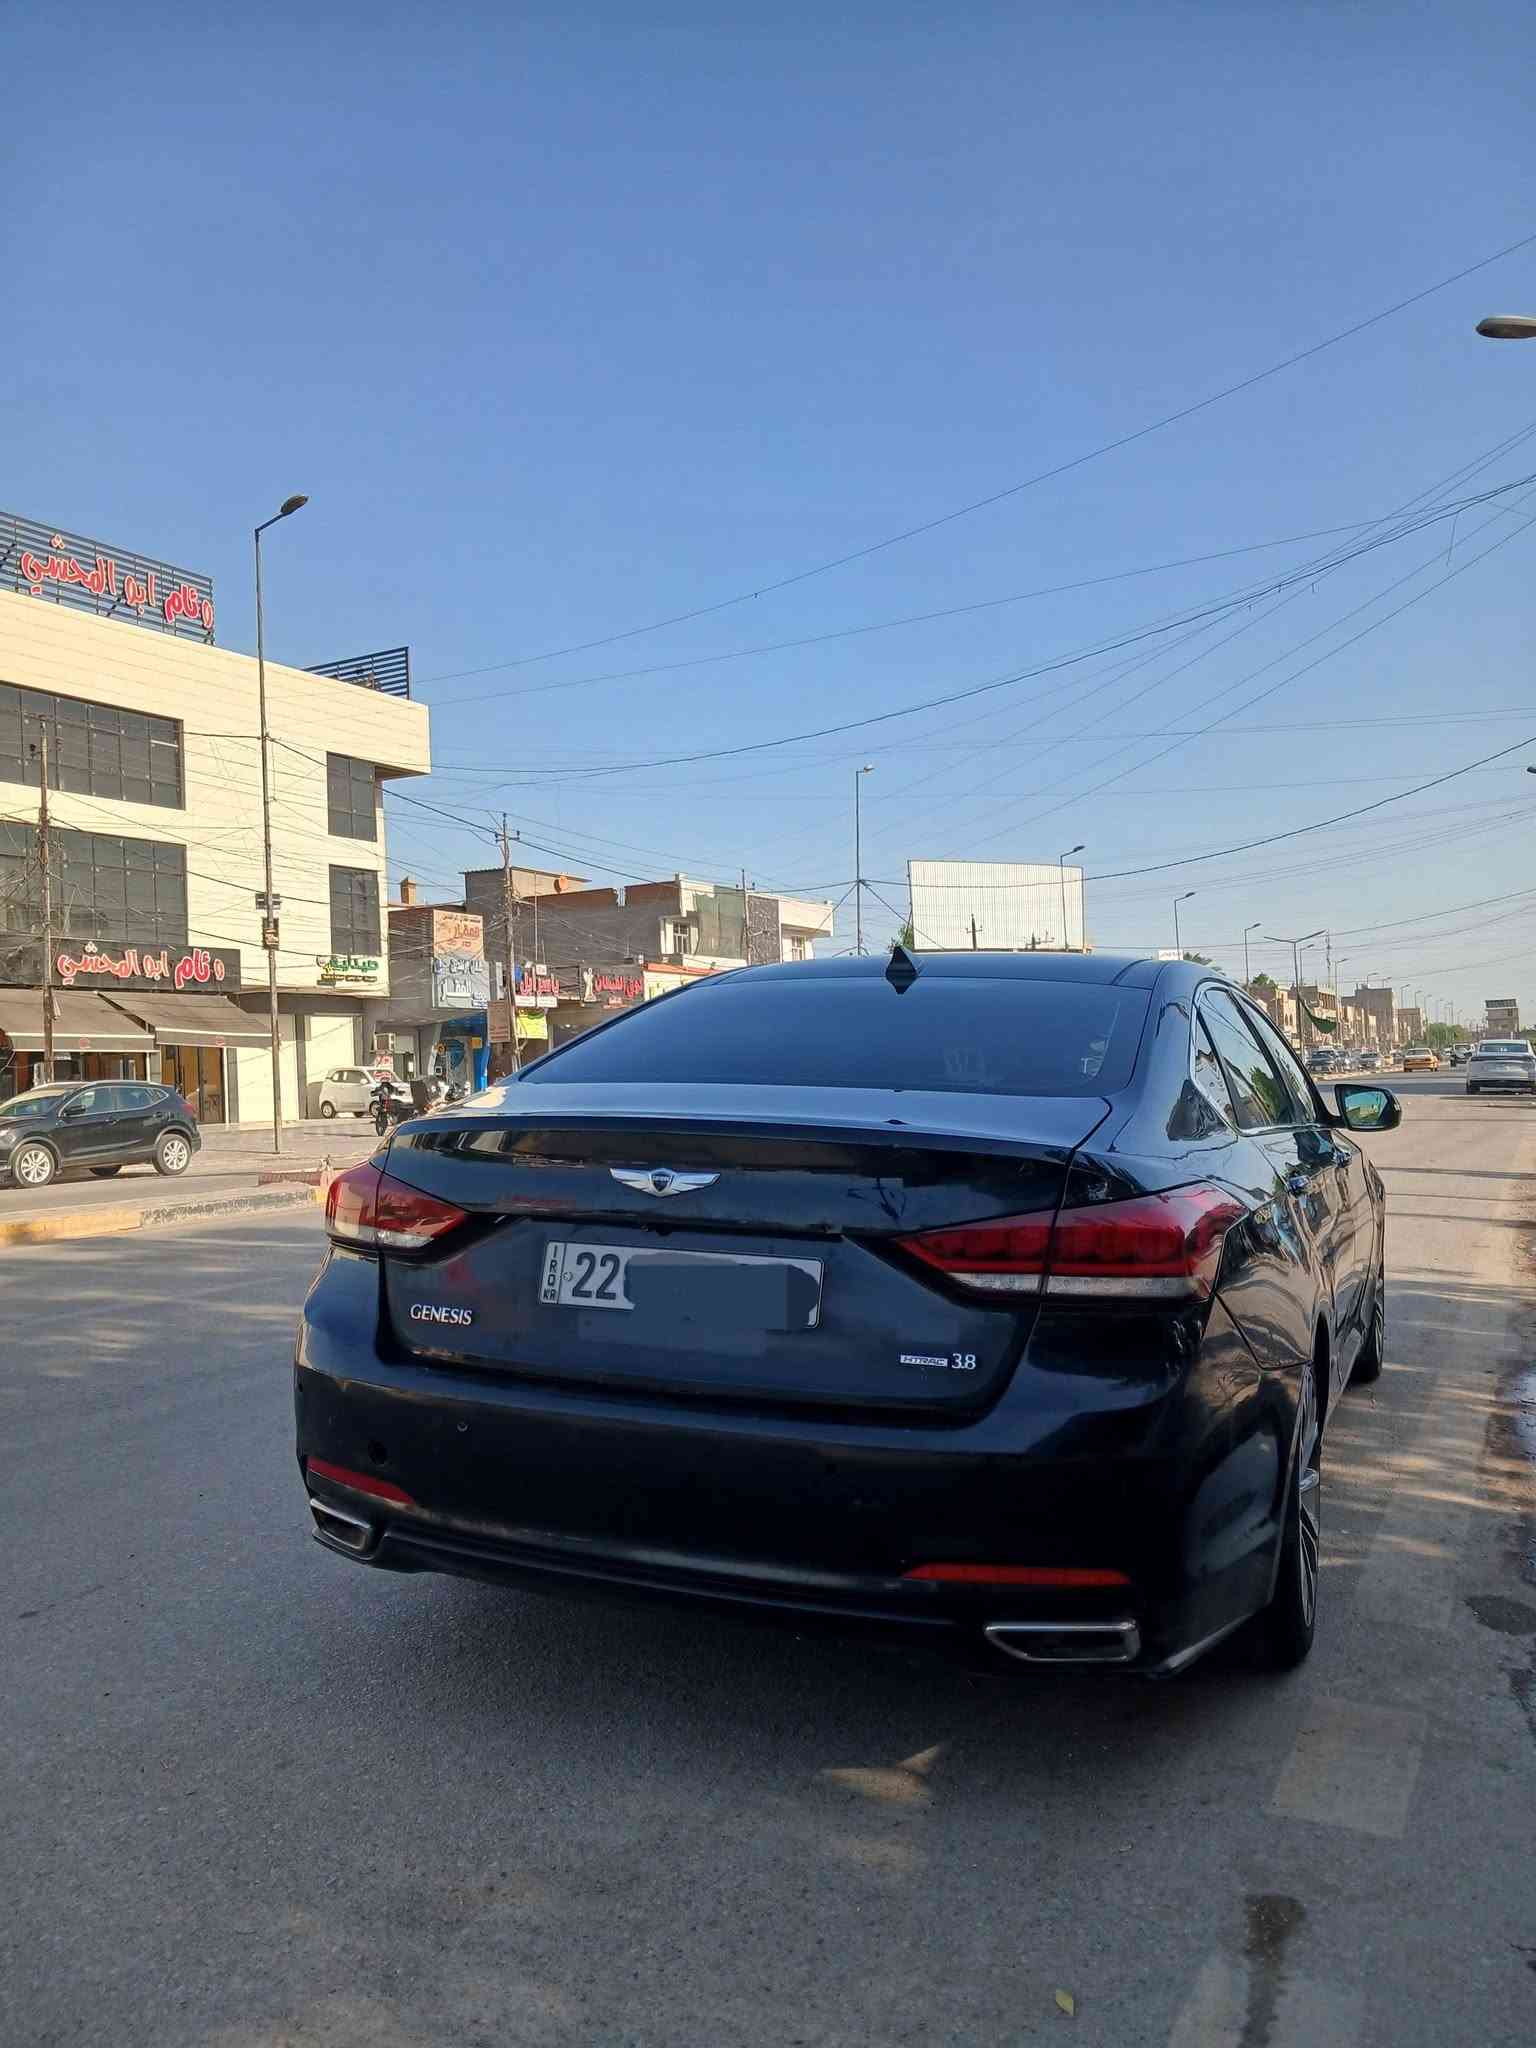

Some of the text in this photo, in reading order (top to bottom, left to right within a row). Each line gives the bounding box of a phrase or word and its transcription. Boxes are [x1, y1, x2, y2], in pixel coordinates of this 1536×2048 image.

[21, 534, 117, 595] المحشي
[57, 941, 141, 986] المحشي
[571, 1251, 620, 1301] 22
[410, 1304, 473, 1325] GENESIS
[951, 1353, 977, 1370] 3.8
